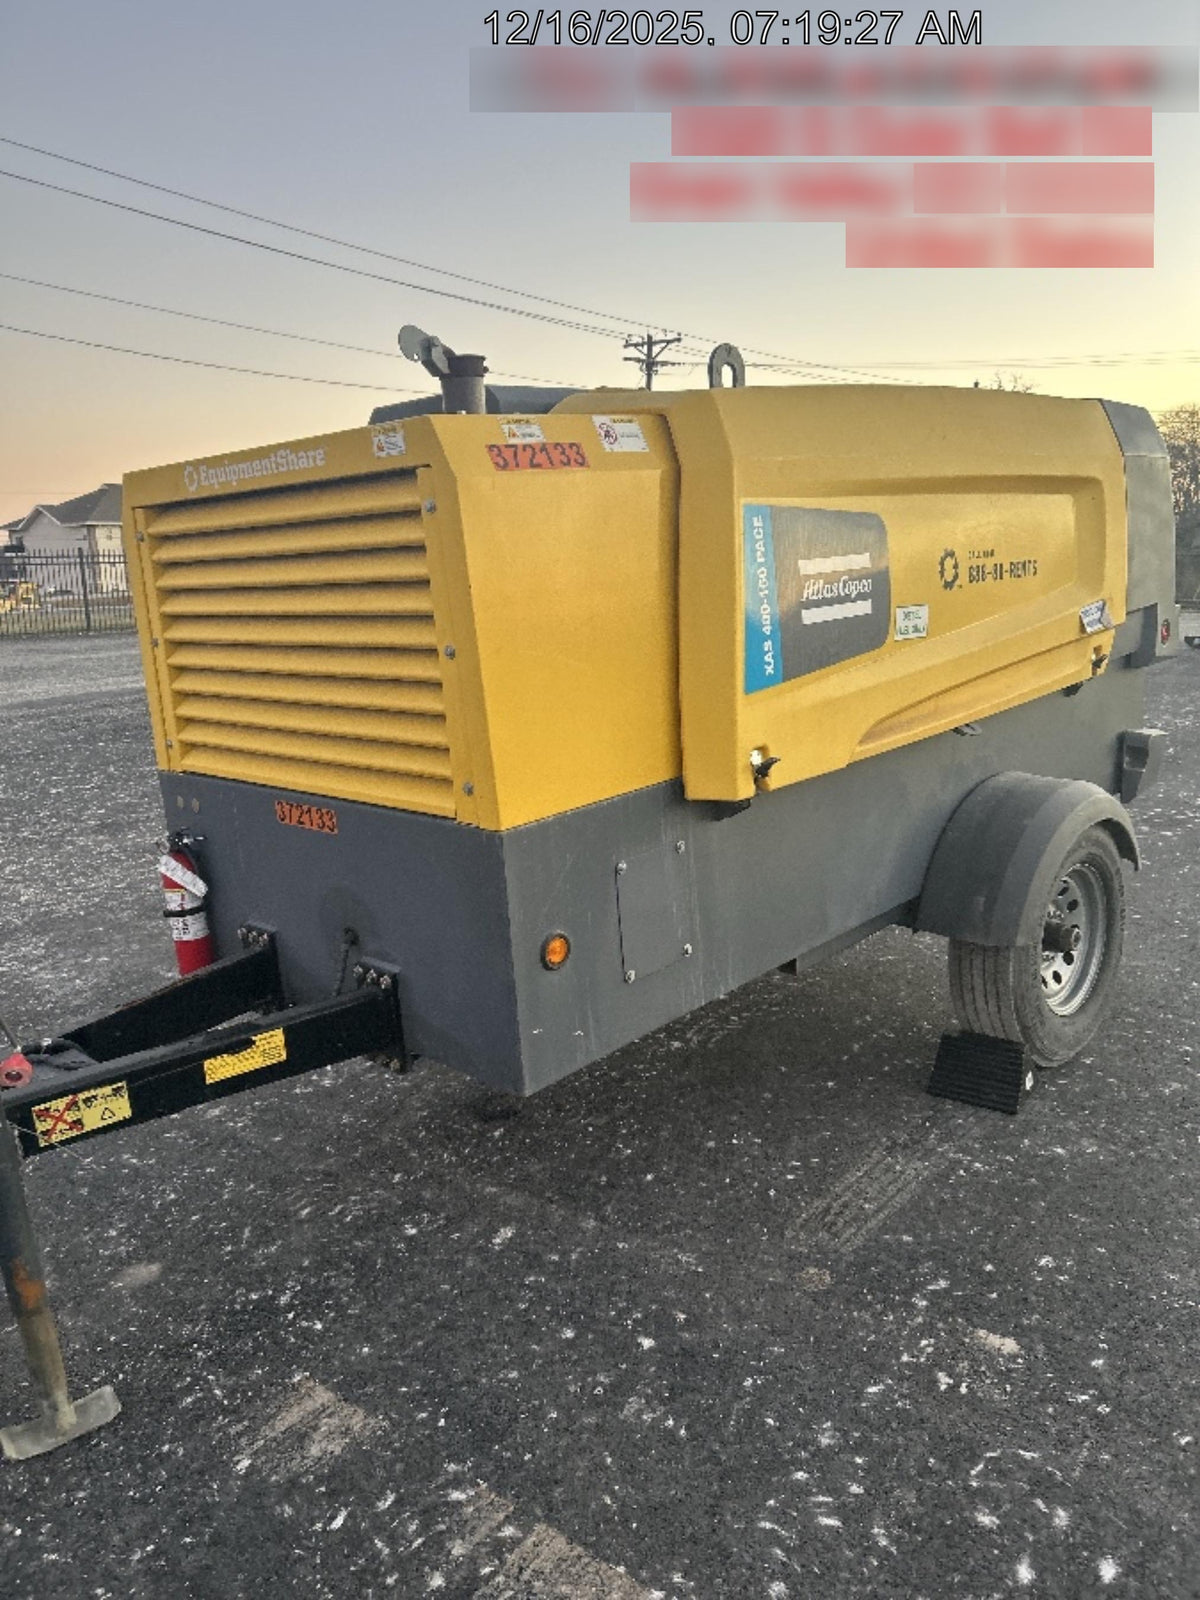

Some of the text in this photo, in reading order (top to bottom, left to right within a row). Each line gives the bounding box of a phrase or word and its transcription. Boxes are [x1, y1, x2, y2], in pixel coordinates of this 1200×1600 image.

[200, 449, 325, 488] EquipmentShare
[488, 443, 586, 468] 372133
[753, 515, 766, 562] PACE
[276, 801, 336, 832] 372133
